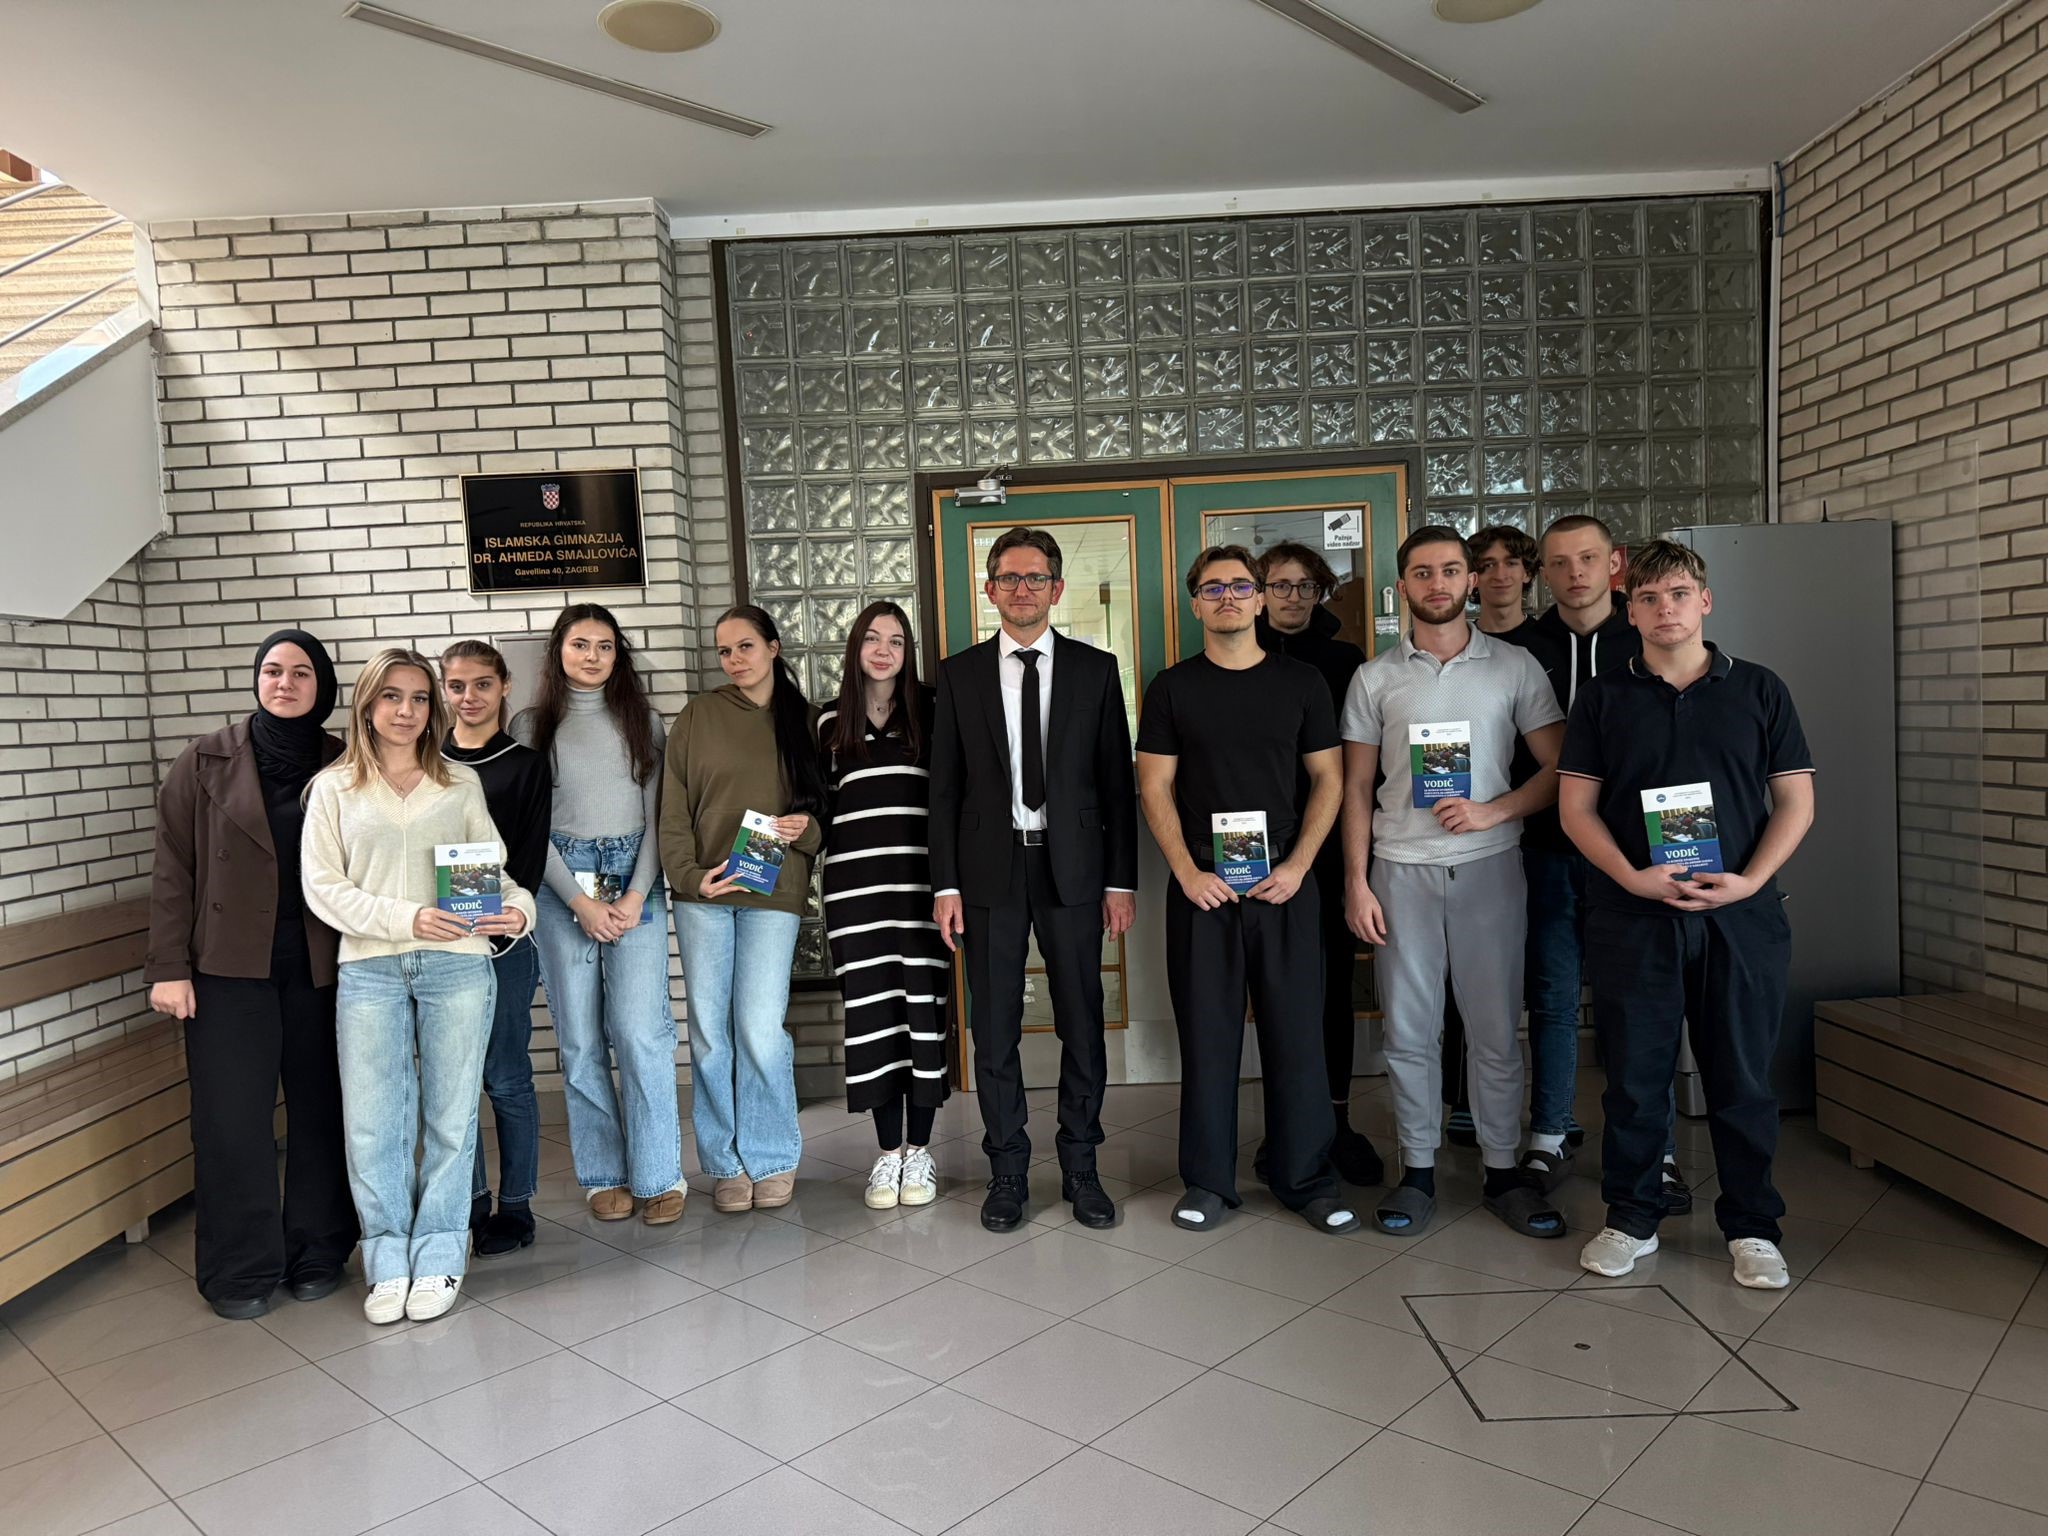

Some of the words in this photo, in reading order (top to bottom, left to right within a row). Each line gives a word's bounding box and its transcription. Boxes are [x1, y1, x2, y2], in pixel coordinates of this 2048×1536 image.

[485, 535, 550, 549] ISLAMSKA
[553, 533, 624, 546] GIMNAZIJA
[473, 553, 496, 564] DR.
[499, 551, 553, 563] AHMEDA
[556, 545, 638, 561] SMAJLOVIĆA
[515, 567, 550, 576] Gavellina
[552, 567, 564, 575] 40,
[565, 565, 599, 575] ZAGREB
[1424, 777, 1454, 788] VODIČ
[1664, 845, 1699, 859] VODIČ
[739, 860, 764, 874] VODIČ
[1224, 865, 1251, 875] VODIČ
[451, 899, 483, 911] VODIČ
